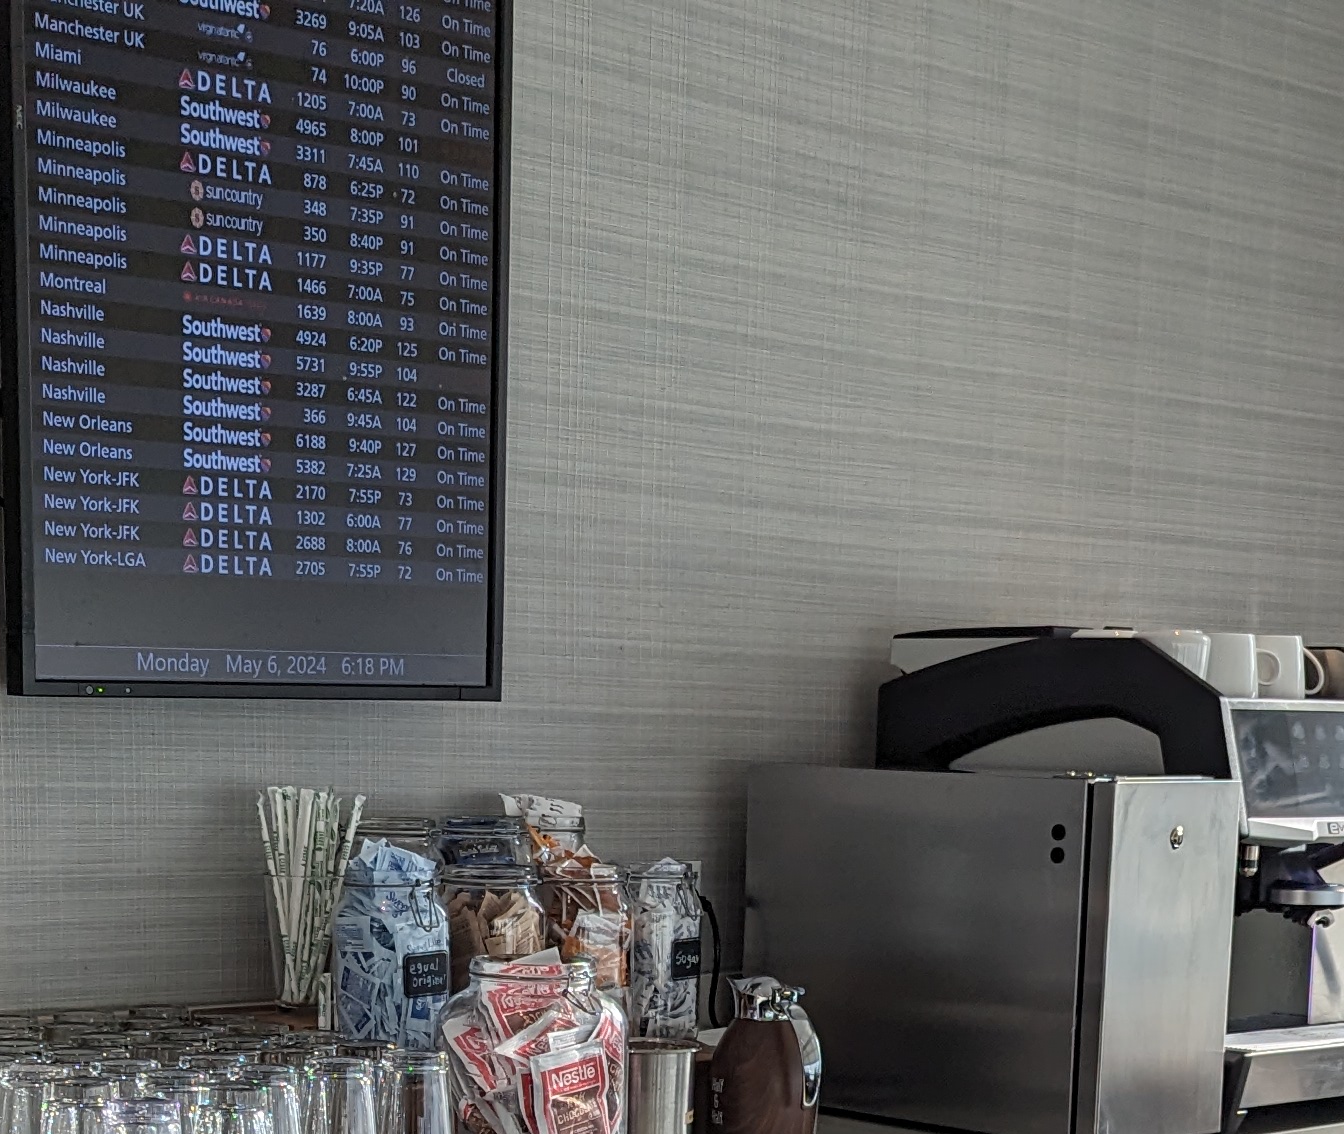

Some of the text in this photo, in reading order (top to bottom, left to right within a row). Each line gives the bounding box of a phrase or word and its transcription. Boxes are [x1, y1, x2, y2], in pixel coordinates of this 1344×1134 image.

[34, 11, 490, 115] Manchester UK 74 10:00P 90 On Time
[50, 0, 485, 88] chester UK 76 6:00P 96 Closed
[295, 9, 491, 64] 3269 9:05A 103 On Time
[15, 104, 24, 130] NEC
[35, 41, 490, 141] Miami DELTA 1205 7:00A 73 On Time
[35, 70, 418, 154] Milwaukee Southwest 4965 8:00P 101
[36, 99, 489, 191] Milwaukee Southwest 3311 7:45A 110 On Time
[37, 128, 489, 216] Minneapolis DELTA 878 6:25P 72 On Time
[37, 157, 127, 186] Minneapolis
[303, 199, 327, 217] 348
[350, 206, 384, 225] 7:35P
[400, 214, 414, 230] 91
[439, 220, 458, 237] On
[460, 223, 489, 241] Time
[38, 185, 127, 214] Minneapolis
[303, 225, 327, 243] 350
[349, 232, 384, 251] 8:40P
[400, 239, 414, 256] 91
[439, 245, 457, 262] On
[460, 248, 489, 266] Time
[38, 214, 488, 291] Minneapolis DELTA 1177 9:35P 77 On Time
[39, 242, 488, 316] Minneapolis DELTA 1466 7:00A 75 On Time
[39, 271, 415, 332] Montreal 1639 8:00A 93
[40, 299, 418, 358] Nashville Southwest 4924 6:20P 125
[41, 327, 418, 383] Nashville Southwest 5731 9:55P 104
[41, 355, 417, 408] Nashville Southwest 3287 6:45A 122
[42, 383, 417, 433] Nashville Southwest 366 9:45A 104
[42, 410, 417, 457] New Orleans Southwest 6188 9:40P 127
[43, 438, 417, 482] New Orleans Southwest 5382 7:25A 129
[43, 465, 413, 507] New York-JFK DELTA 2170 7:55P 73
[44, 493, 413, 531] New York-JFK DELTA 1302 6:00A 77
[44, 520, 413, 555] New York-JFK DELTA 2688 8:00A 76
[45, 547, 412, 580] New York-LGA DELTA 2705 7:55P 72
[136, 652, 405, 678] Monday May 6, 2024 6:18 PM
